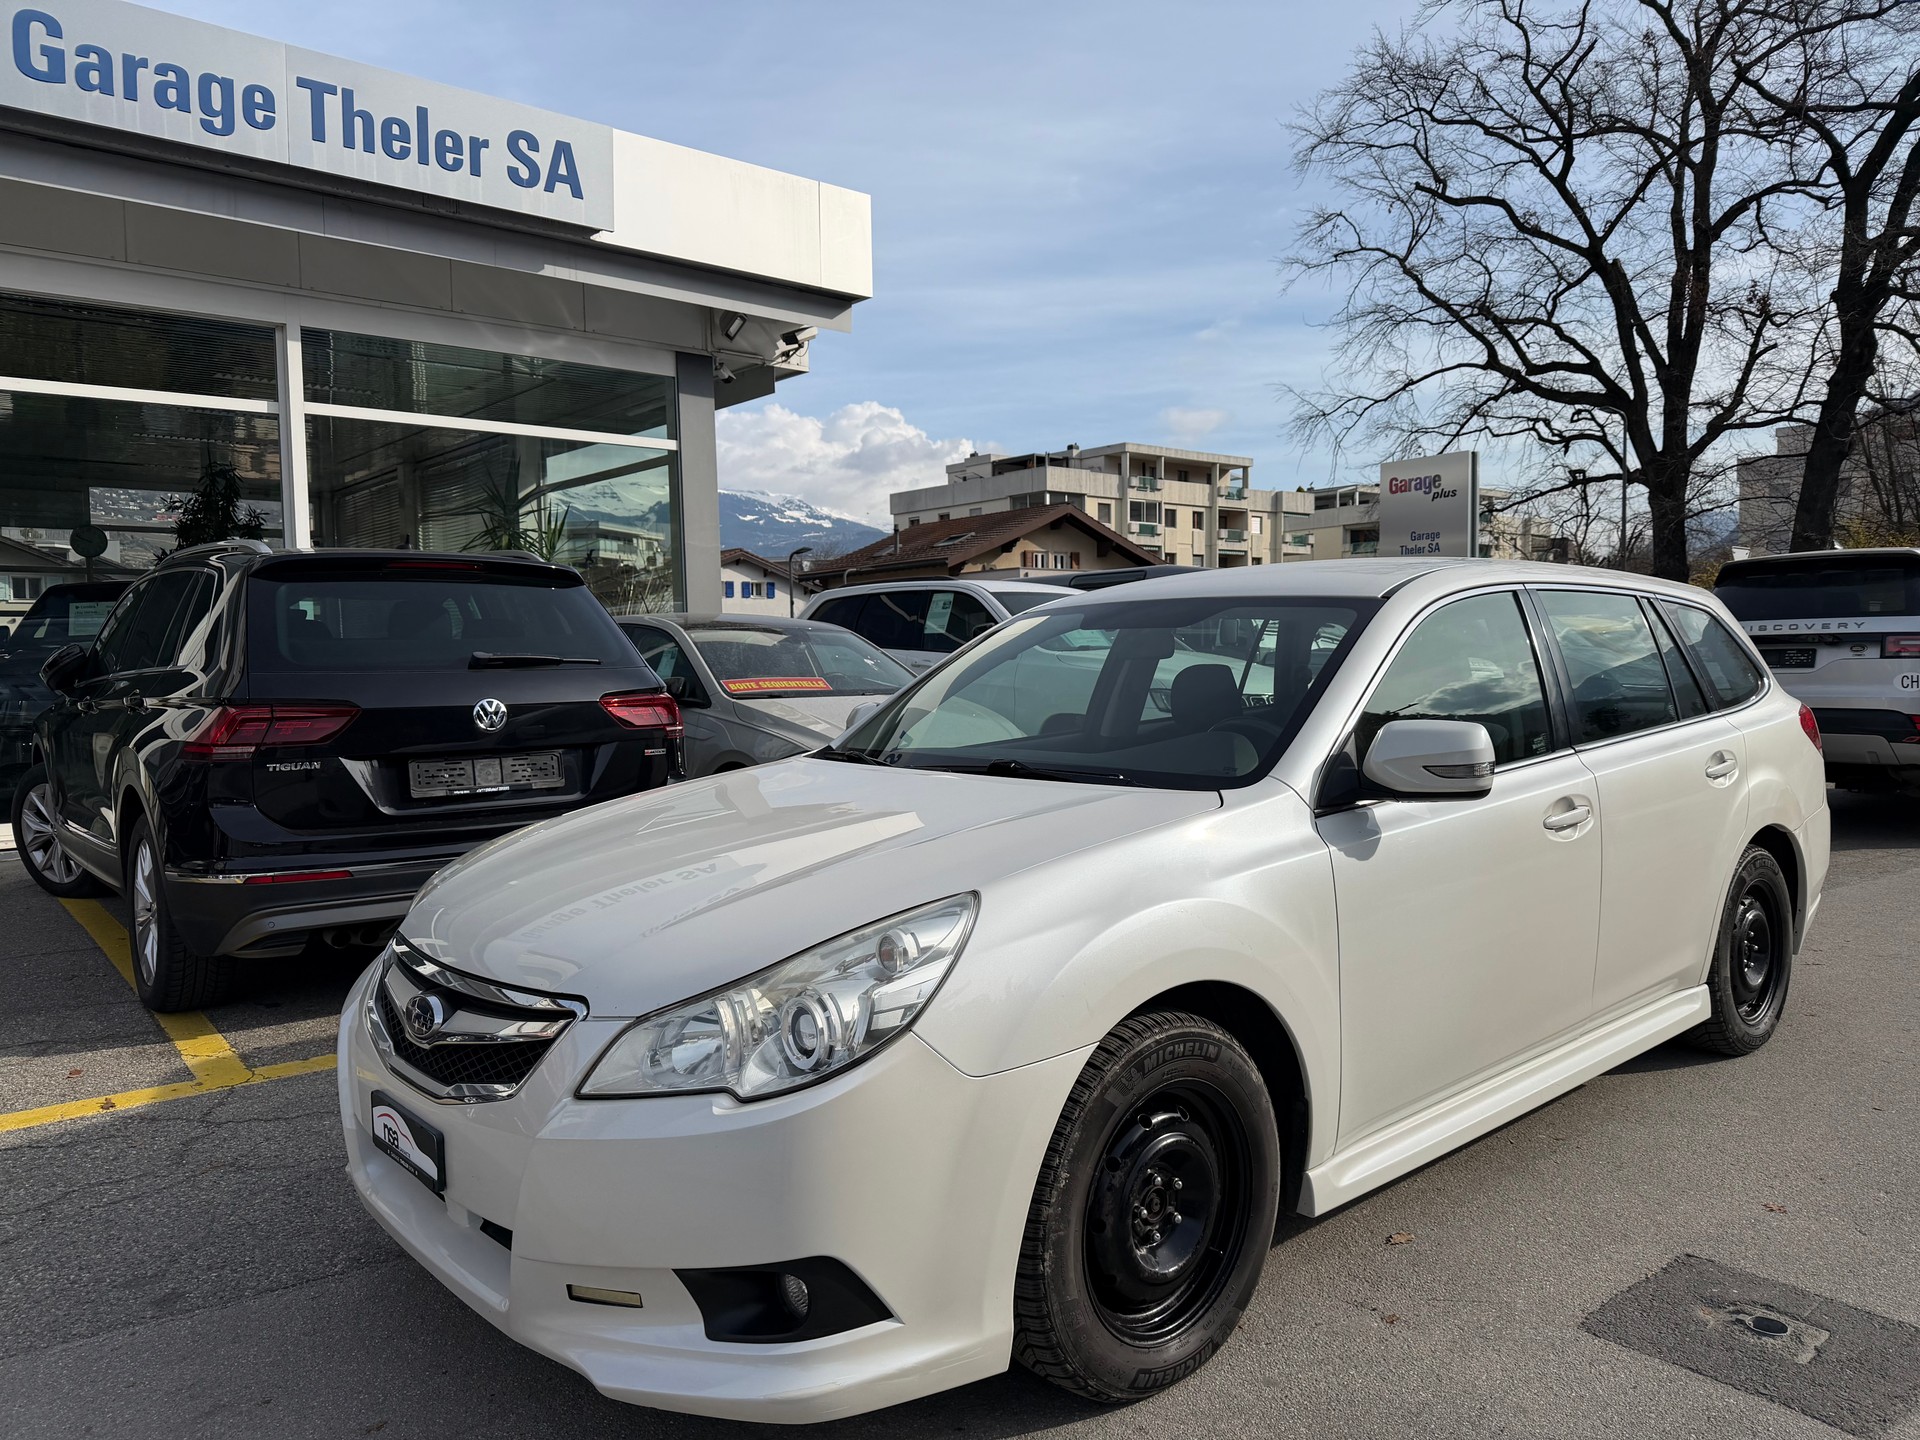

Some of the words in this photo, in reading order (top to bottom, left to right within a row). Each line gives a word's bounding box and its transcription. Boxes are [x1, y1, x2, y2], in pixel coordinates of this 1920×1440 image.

[12, 9, 276, 137] Garage
[296, 76, 490, 178] Theler
[506, 129, 585, 200] SA
[1389, 474, 1442, 495] Garage
[1431, 488, 1458, 502] plus
[1410, 531, 1441, 542] Garage
[1400, 544, 1426, 556] Theler
[1427, 542, 1441, 554] SA
[1901, 674, 1920, 689] CH
[266, 761, 321, 772] TIGUAN
[1144, 1042, 1218, 1073] MICHELIN
[383, 1122, 399, 1149] nsa
[1133, 1342, 1214, 1389] MICHELIN
